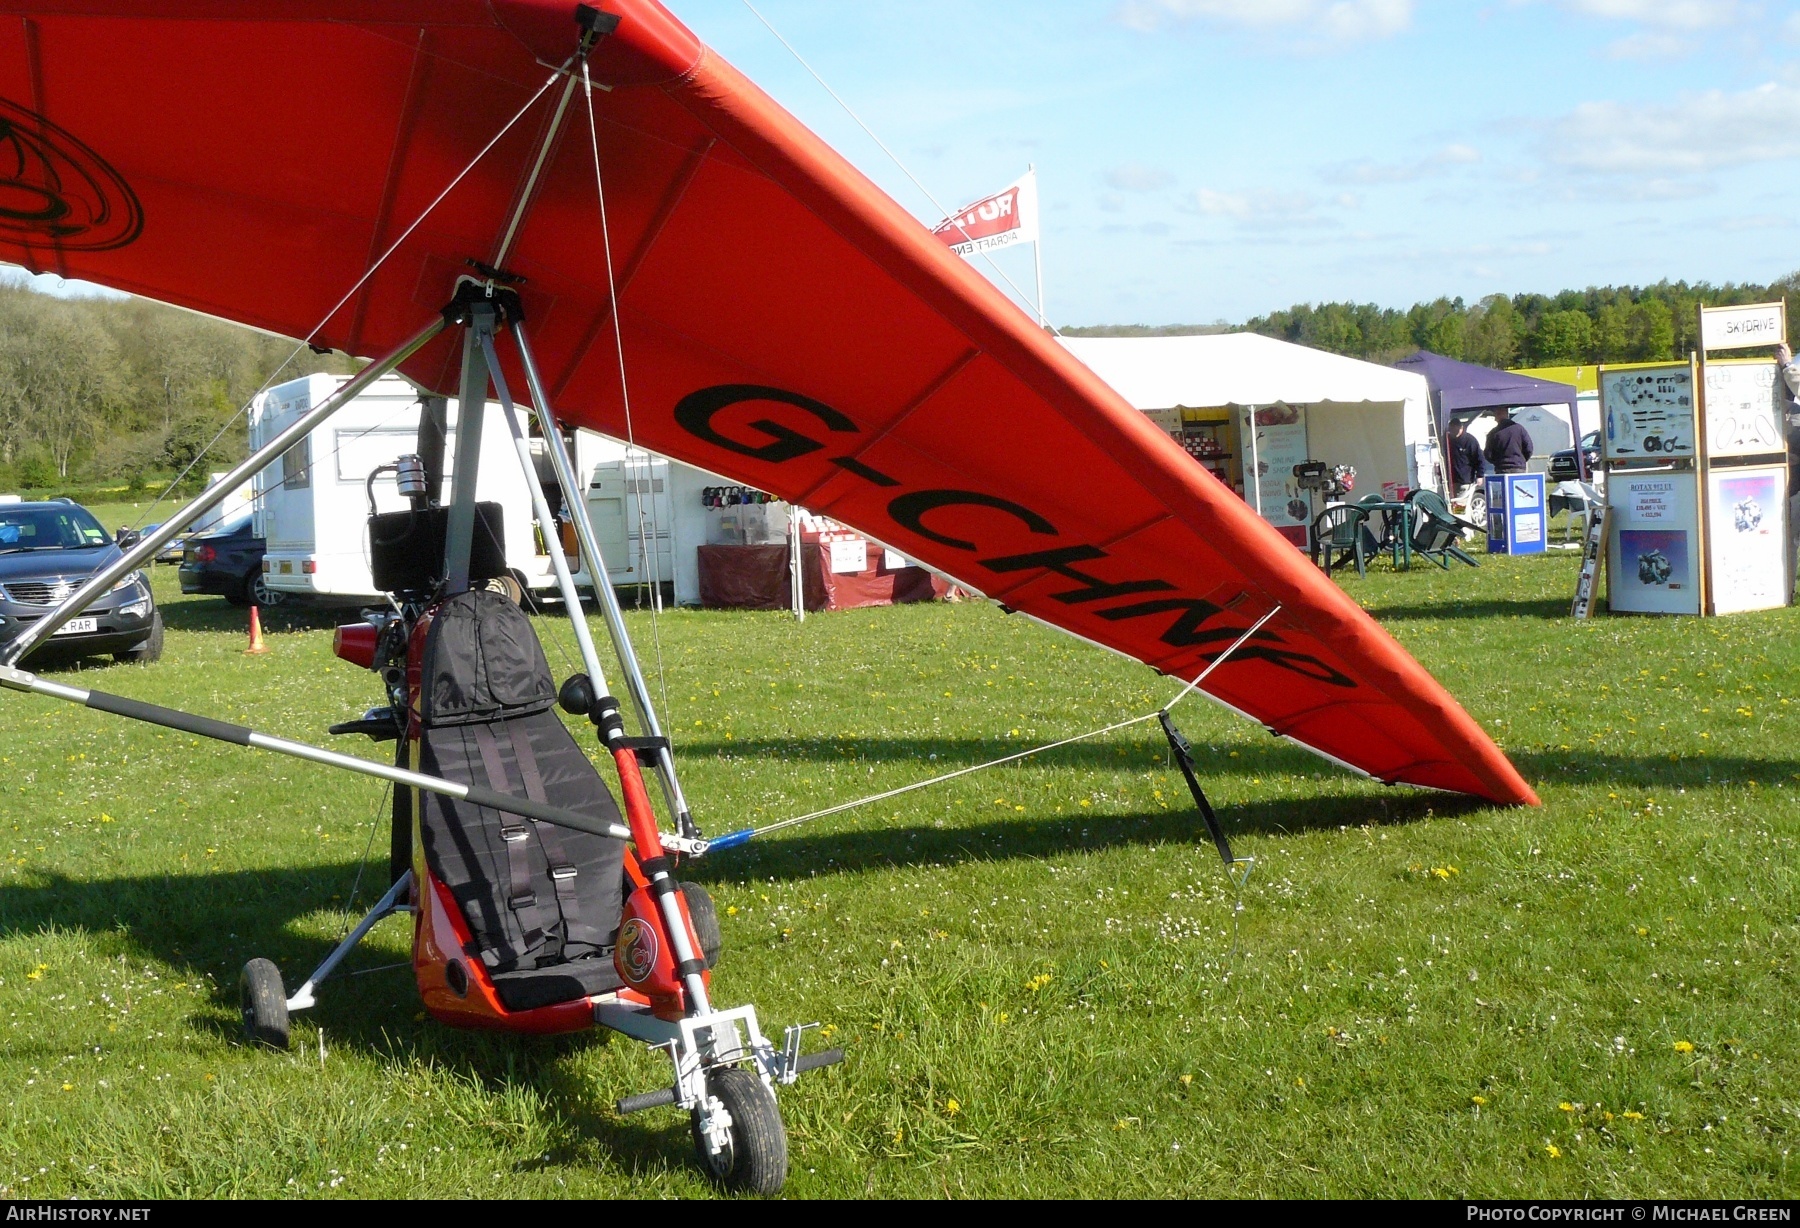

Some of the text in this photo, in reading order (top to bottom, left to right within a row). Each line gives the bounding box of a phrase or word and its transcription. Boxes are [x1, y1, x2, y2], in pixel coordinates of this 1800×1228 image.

[1726, 317, 1775, 334] SKYDRIVE
[673, 383, 1358, 688] G-CHNP
[70, 620, 91, 631] RAR
